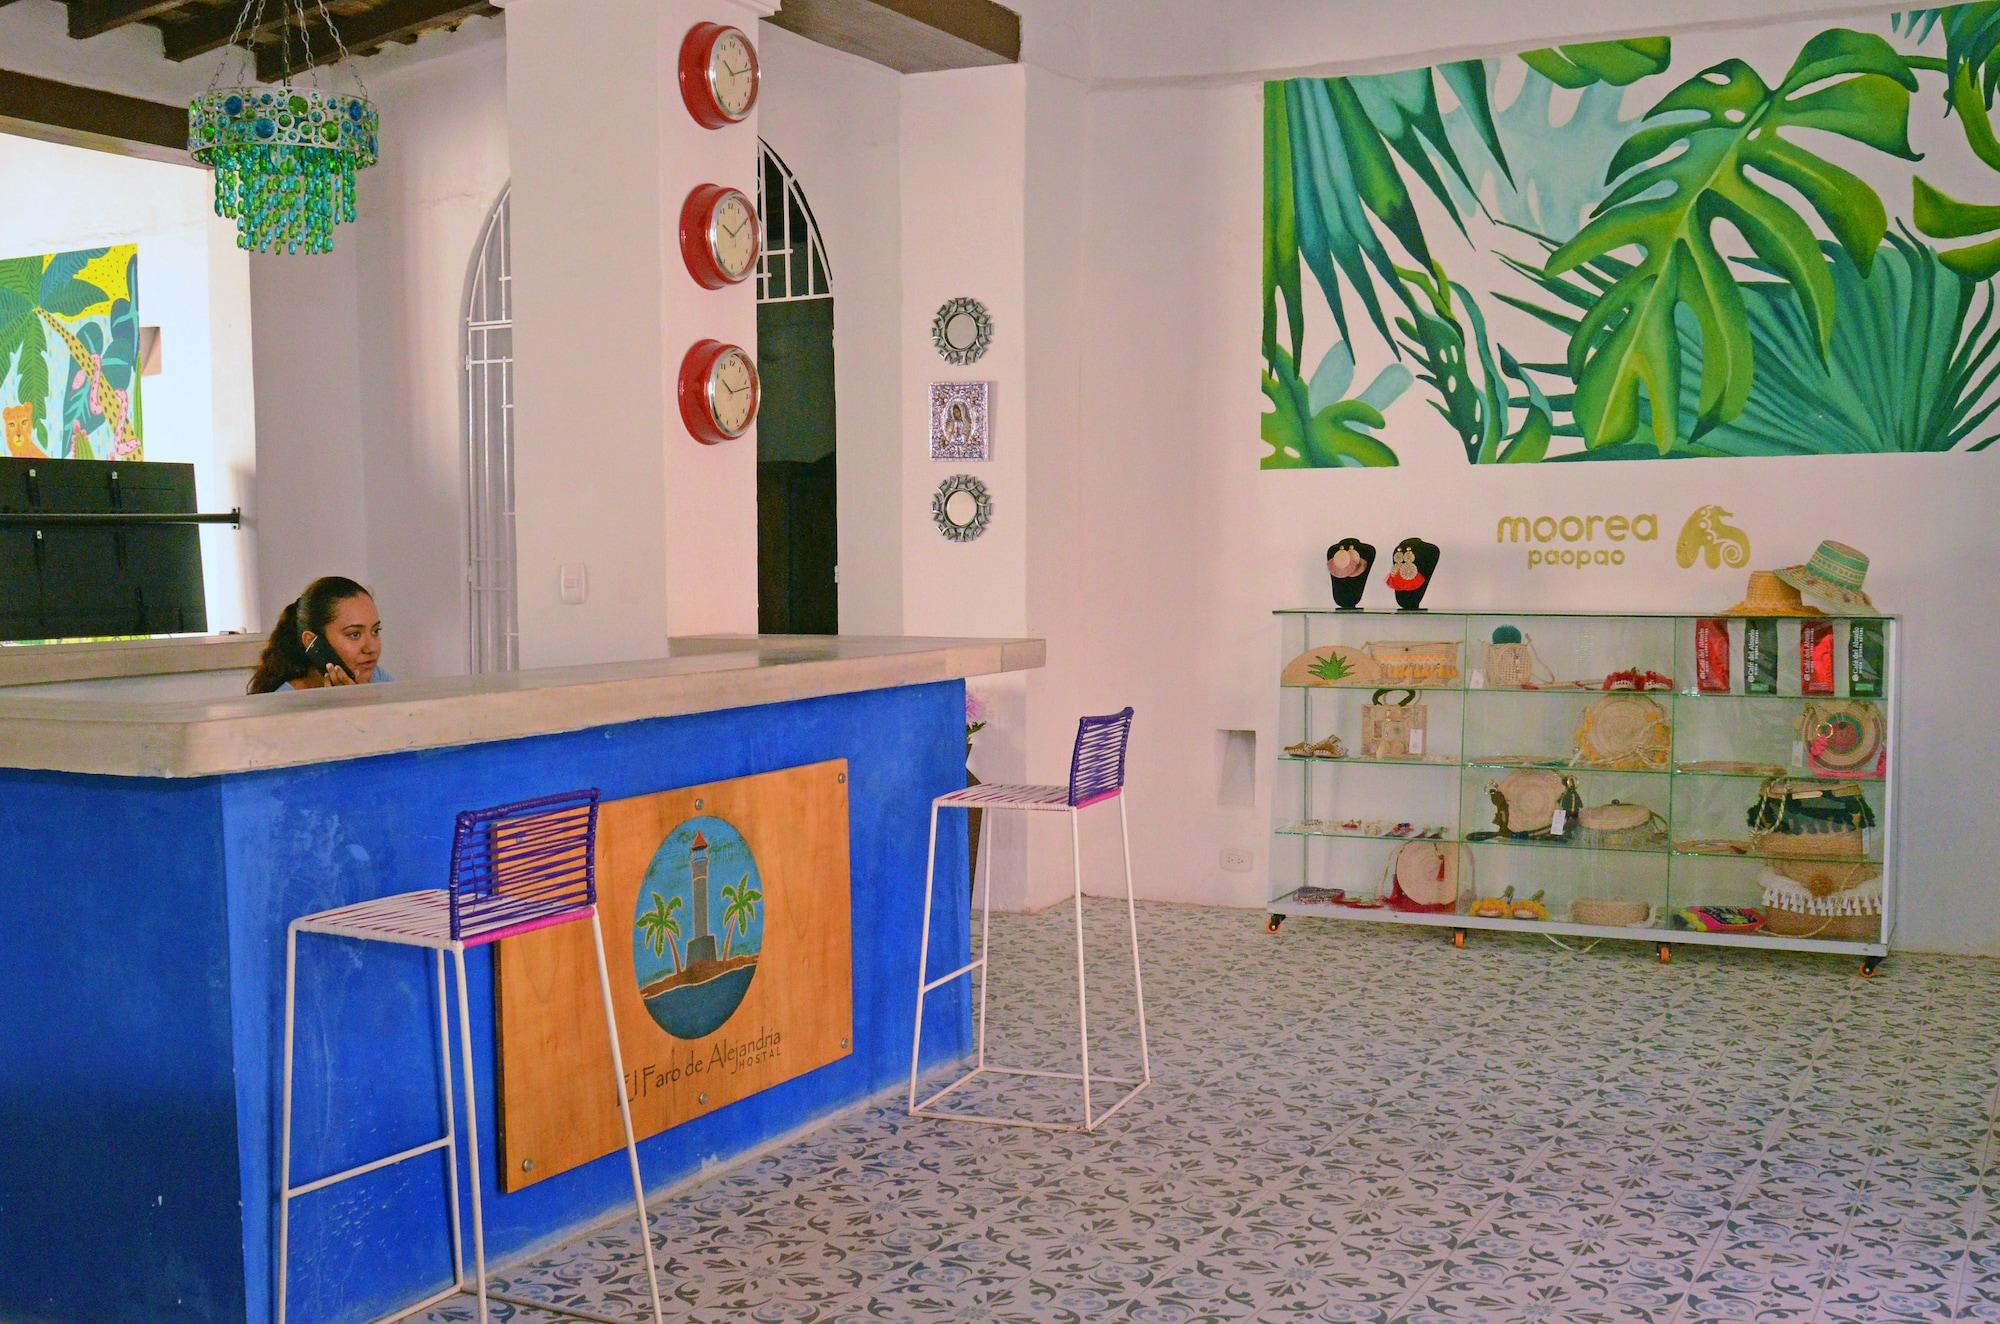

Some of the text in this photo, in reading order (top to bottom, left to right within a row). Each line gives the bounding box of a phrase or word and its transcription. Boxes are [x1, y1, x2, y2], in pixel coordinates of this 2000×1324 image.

[1497, 514, 1659, 544] moorea
[1528, 549, 1626, 570] paopao
[739, 1047, 781, 1071] HOSTAL
[642, 1064, 681, 1097] Faro
[684, 1050, 704, 1077] de
